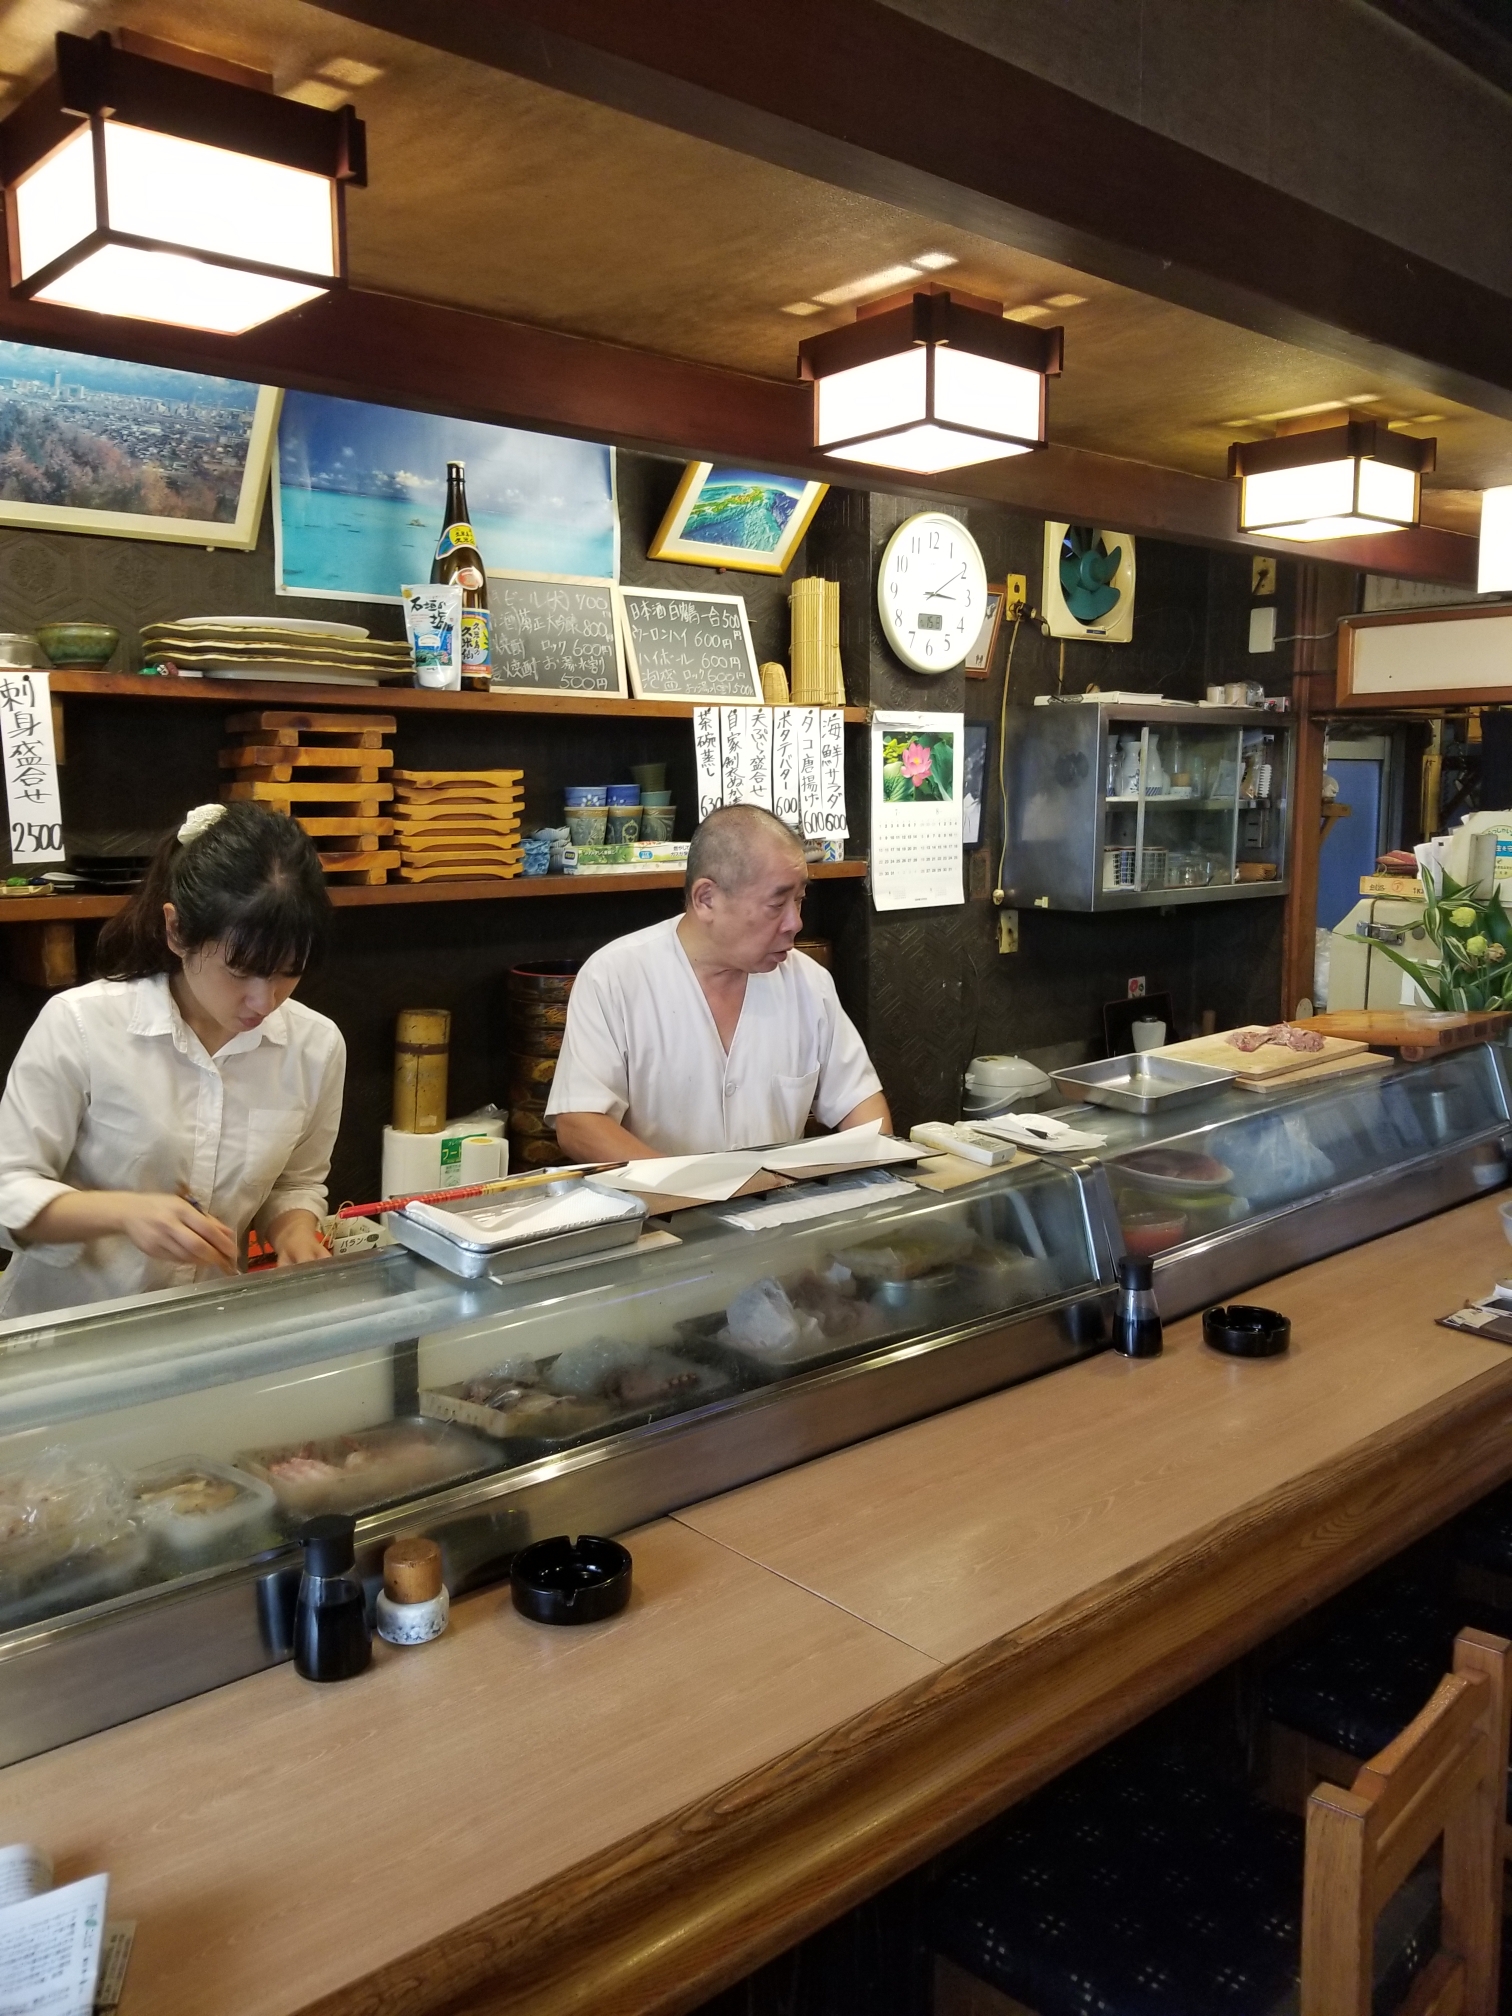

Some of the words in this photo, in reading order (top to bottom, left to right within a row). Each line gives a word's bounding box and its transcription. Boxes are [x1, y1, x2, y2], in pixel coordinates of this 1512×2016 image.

[912, 537, 921, 554] 11
[929, 532, 940, 549] 12
[896, 555, 908, 573] 10
[961, 562, 967, 579] 2
[890, 582, 898, 599] 9
[965, 589, 971, 607] 3
[894, 609, 903, 627] 8
[957, 617, 964, 633] 4
[909, 631, 916, 648] 7
[925, 639, 933, 656] 6
[944, 634, 951, 651] 5
[0, 678, 52, 804] 刺身盛合せ
[697, 709, 717, 777] 茶碗蒸し
[801, 715, 820, 808] タコ唐揚げ
[821, 716, 842, 809] 海鮮サラダ
[776, 797, 797, 816] 600
[804, 810, 824, 834] 600
[825, 813, 847, 831] 600
[12, 822, 63, 853] 2500
